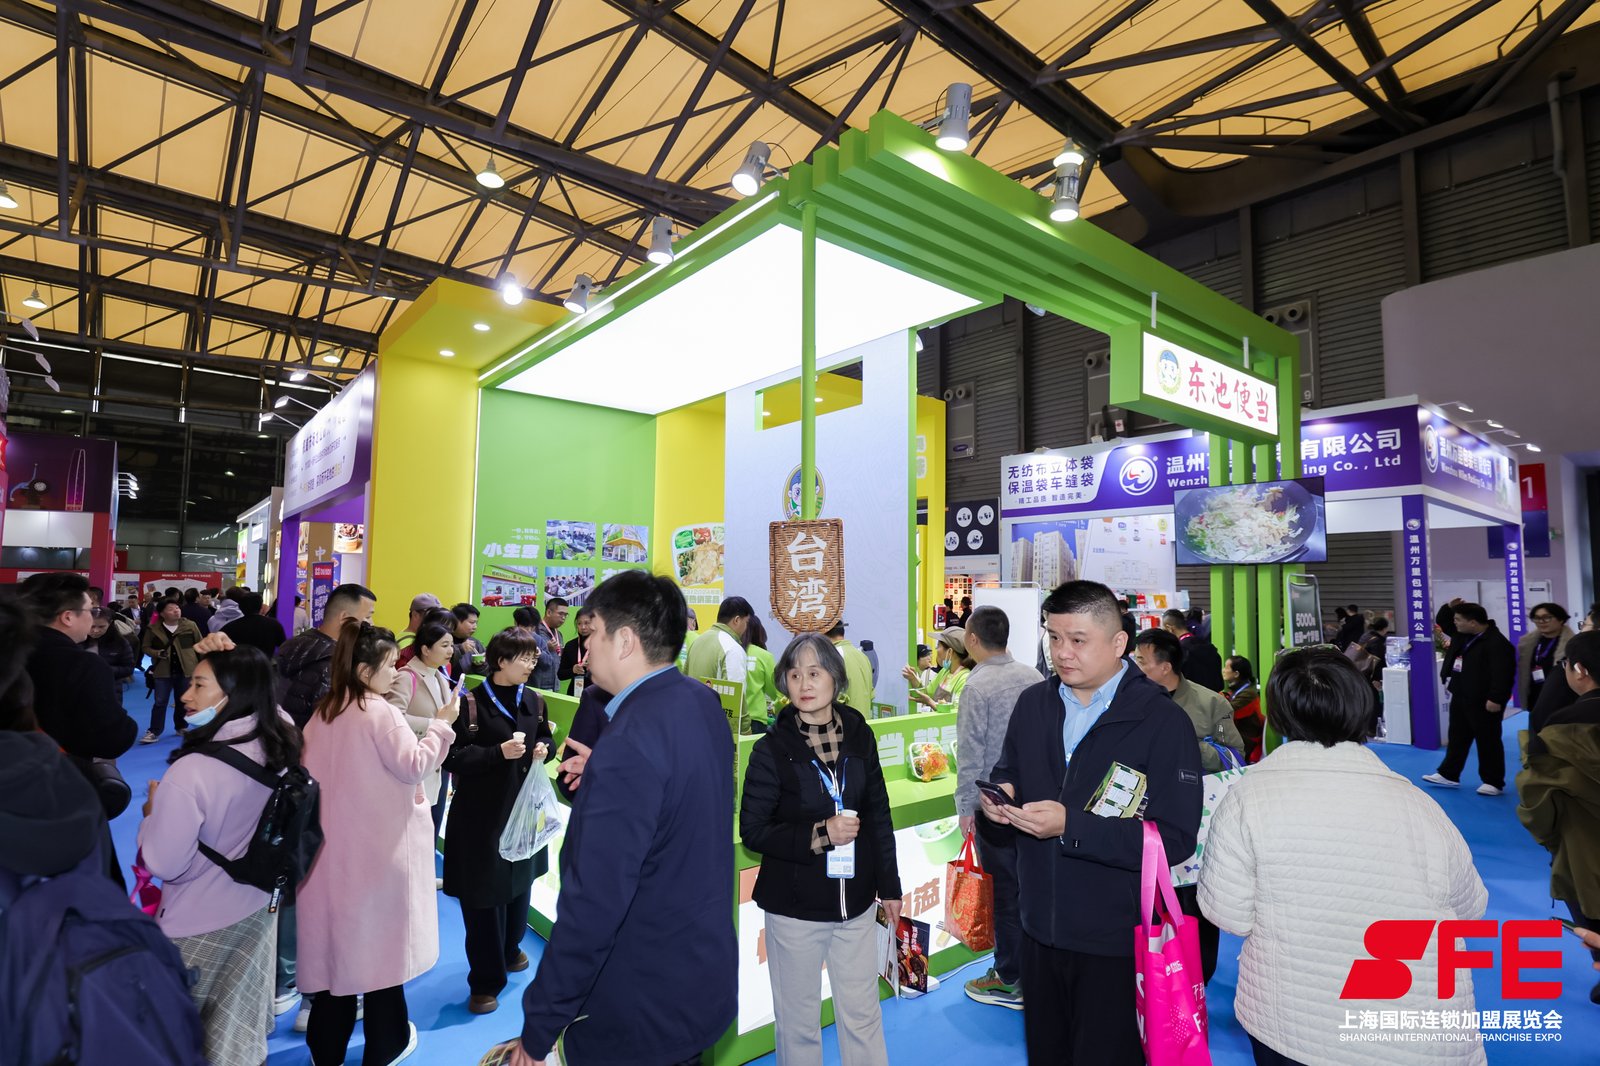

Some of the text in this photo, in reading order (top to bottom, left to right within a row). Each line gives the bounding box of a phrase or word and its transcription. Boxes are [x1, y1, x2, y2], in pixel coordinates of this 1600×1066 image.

[1188, 359, 1270, 424] 东池便当
[1007, 455, 1095, 480] 无纺布立体袋
[1167, 475, 1208, 489] Wenzh
[1375, 454, 1401, 468] Ltd
[1007, 472, 1095, 495] 保温袋车缝袋
[1521, 476, 1534, 499] 1
[786, 532, 829, 620] 台湾
